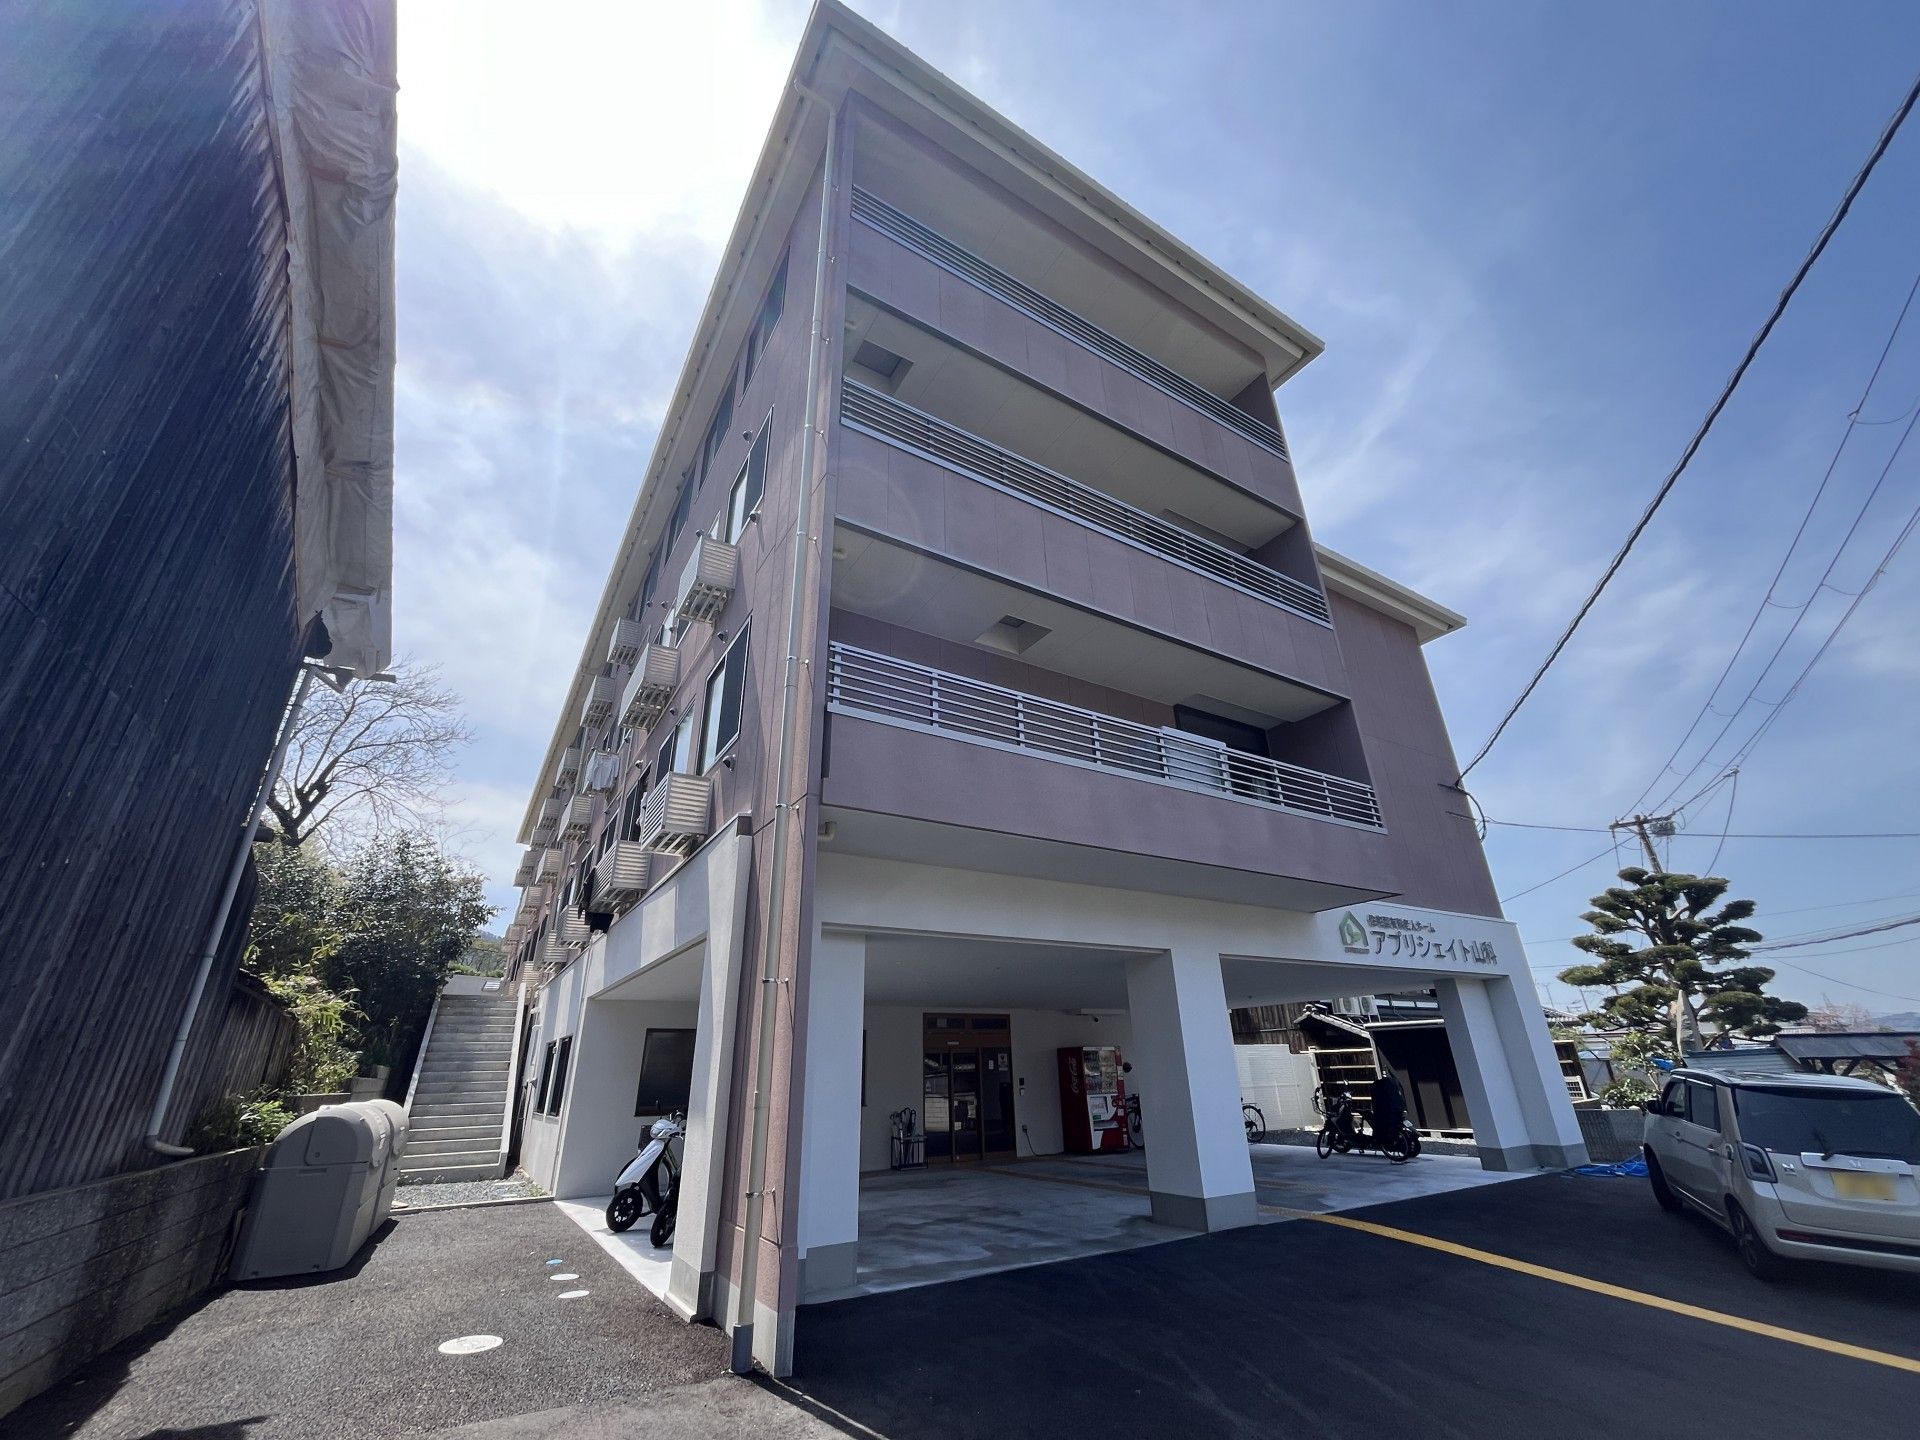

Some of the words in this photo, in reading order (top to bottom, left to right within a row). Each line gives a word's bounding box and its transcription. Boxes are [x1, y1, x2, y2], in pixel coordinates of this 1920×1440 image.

[1370, 931, 1498, 966] アプリシェイト山科
